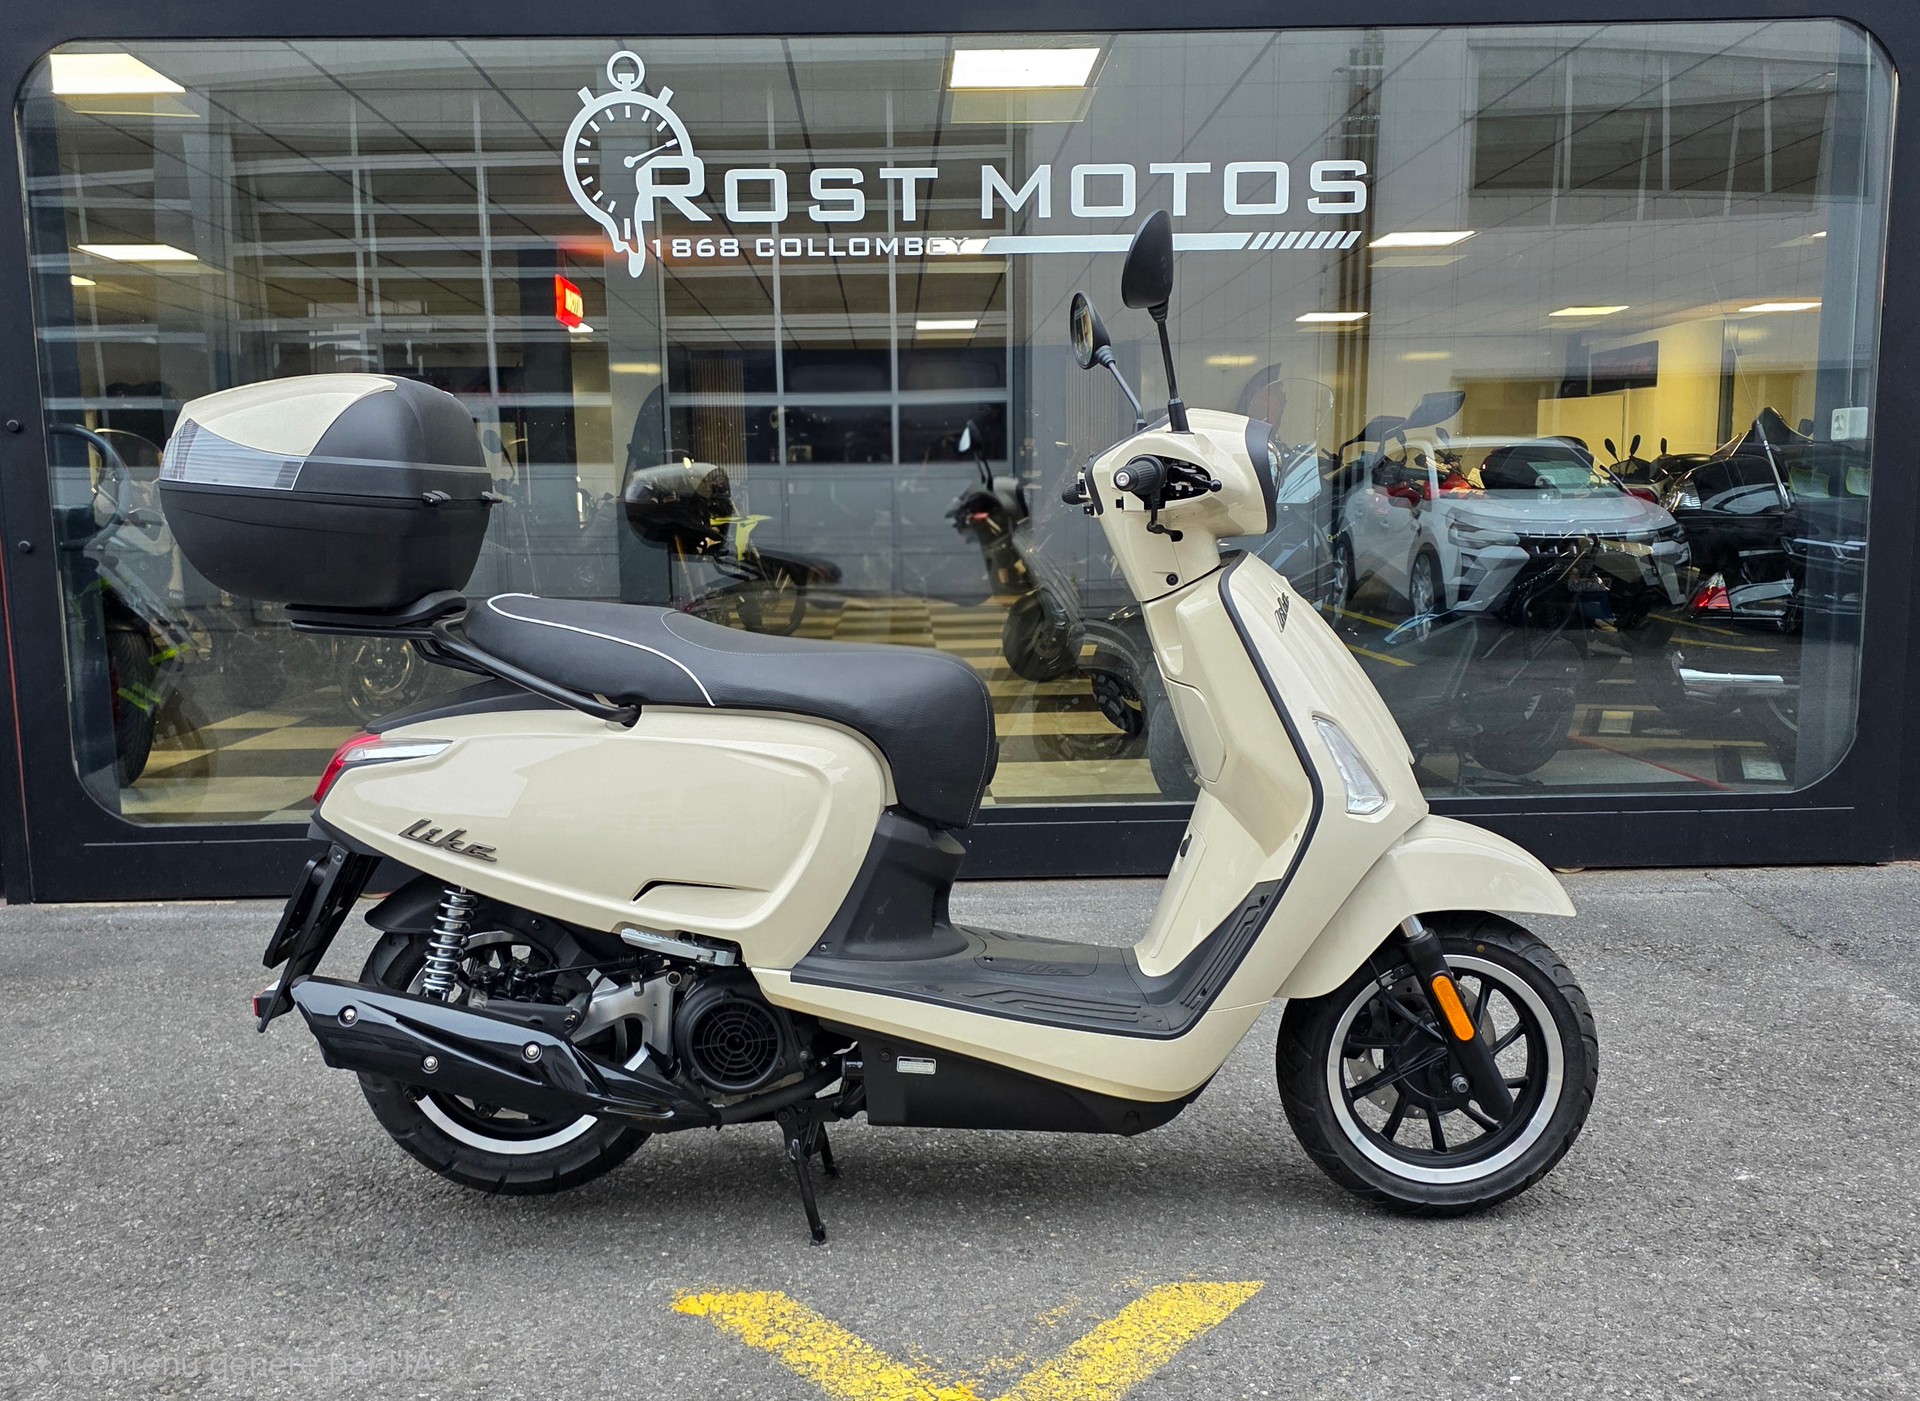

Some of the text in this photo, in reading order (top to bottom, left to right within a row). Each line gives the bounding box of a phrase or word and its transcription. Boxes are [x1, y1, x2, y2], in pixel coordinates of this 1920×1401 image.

[636, 155, 1368, 223] ROST MOTOS
[652, 236, 970, 258] 1868 COLLOMBEY
[398, 818, 498, 862] Like
